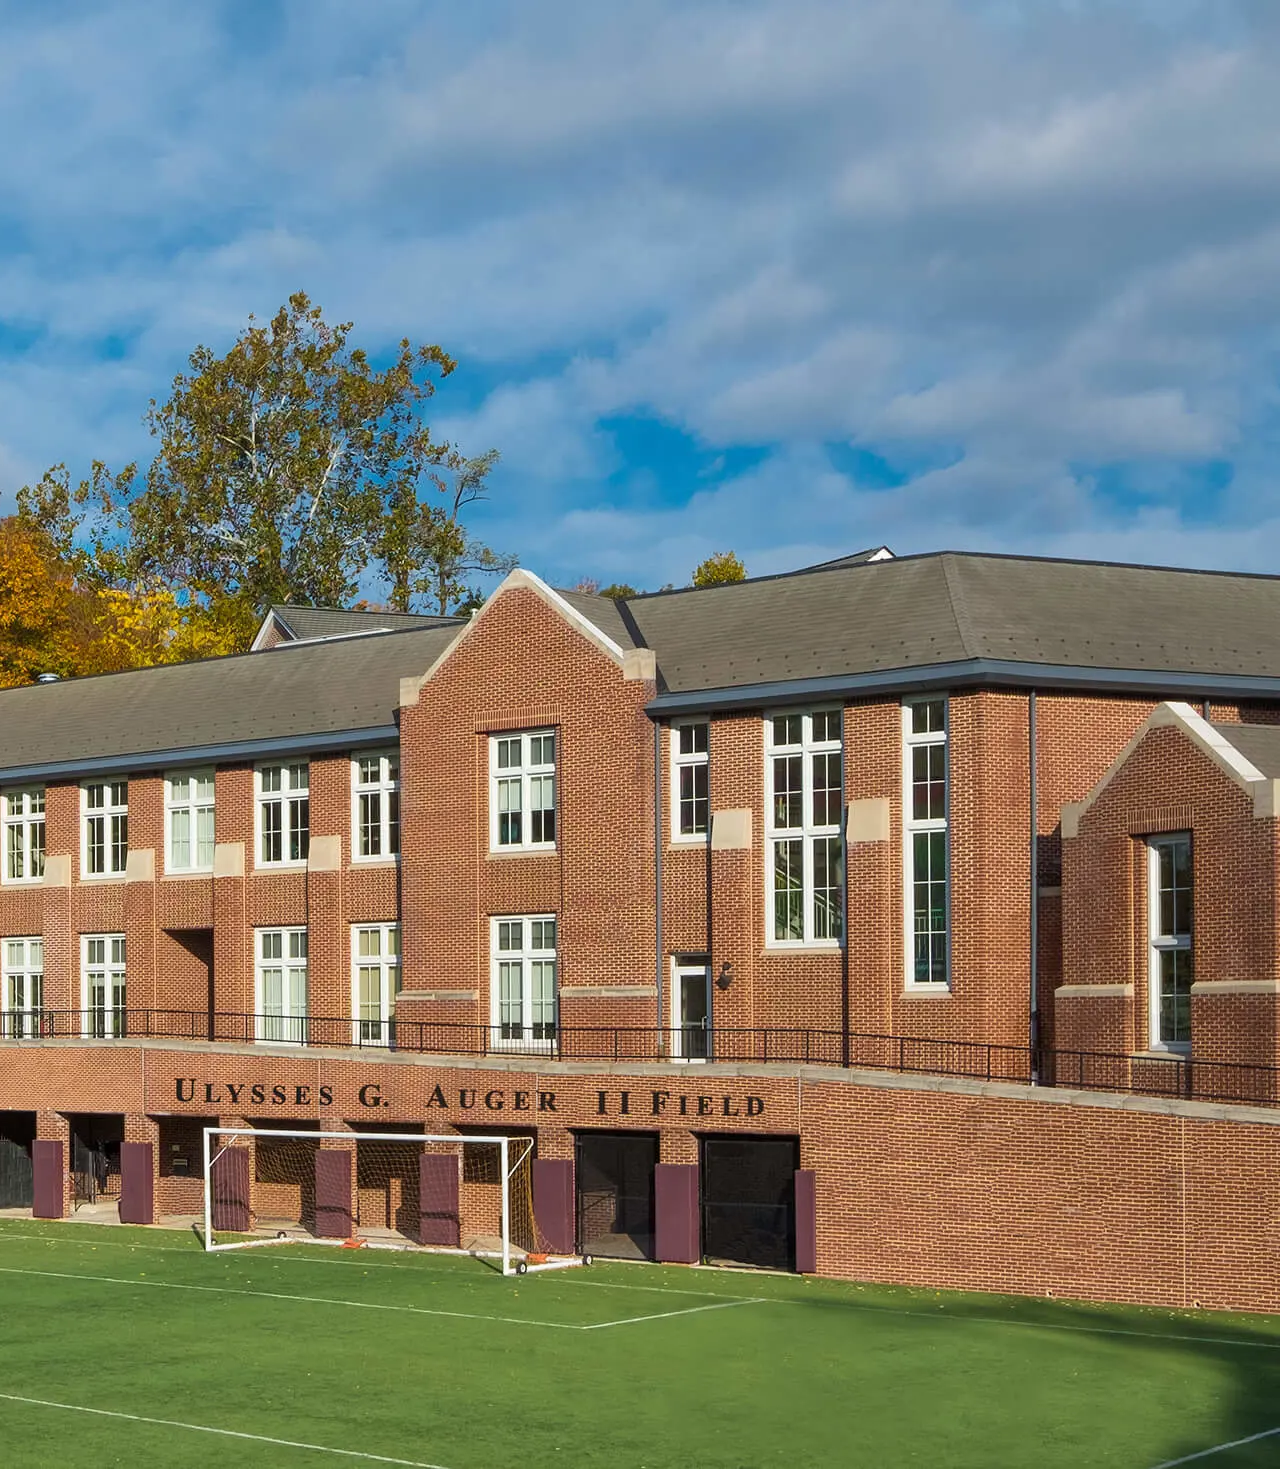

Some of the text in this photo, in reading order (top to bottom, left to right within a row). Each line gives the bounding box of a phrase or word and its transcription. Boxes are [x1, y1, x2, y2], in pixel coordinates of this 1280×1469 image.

[174, 1078, 765, 1116] ULYSSES G. AUGER II FIELD
